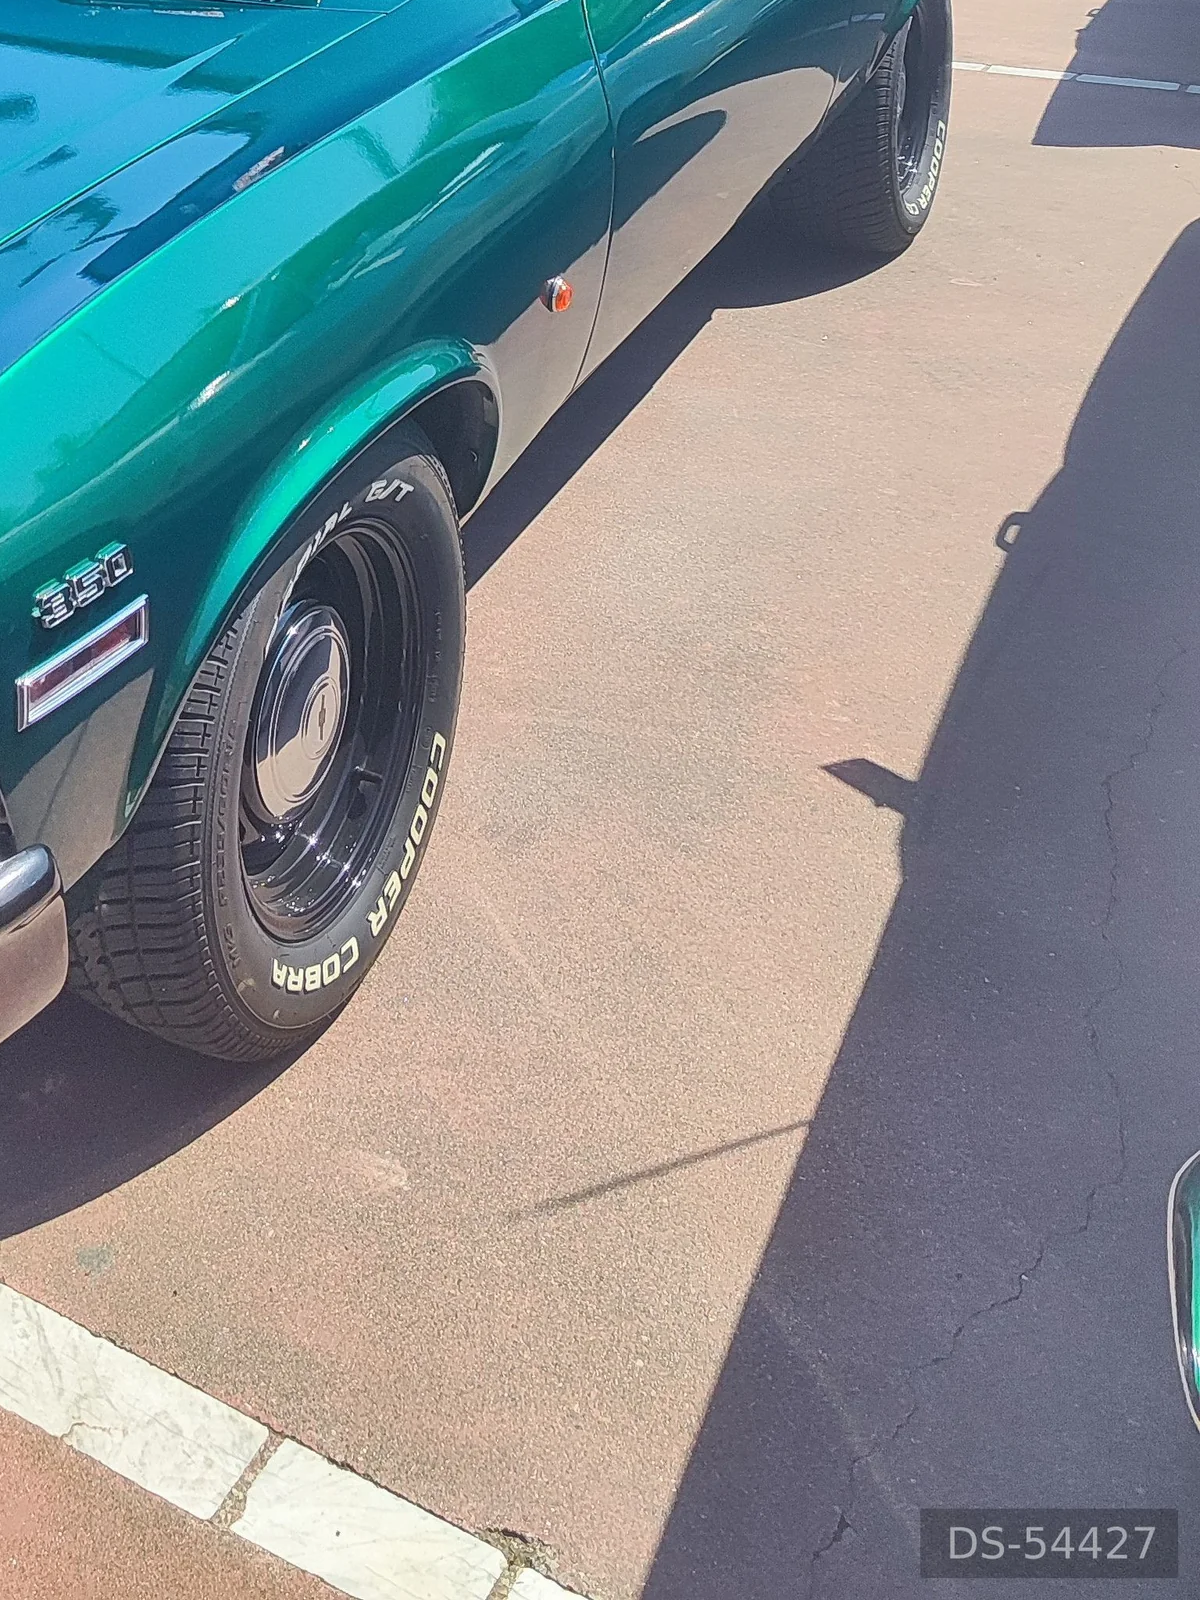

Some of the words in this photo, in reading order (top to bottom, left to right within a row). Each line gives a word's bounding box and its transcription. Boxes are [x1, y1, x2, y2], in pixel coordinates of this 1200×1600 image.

[917, 119, 946, 210] COOPER
[365, 479, 414, 502] G/T
[34, 542, 134, 629] 350
[367, 731, 447, 938] COOPER
[272, 936, 360, 992] COBRA
